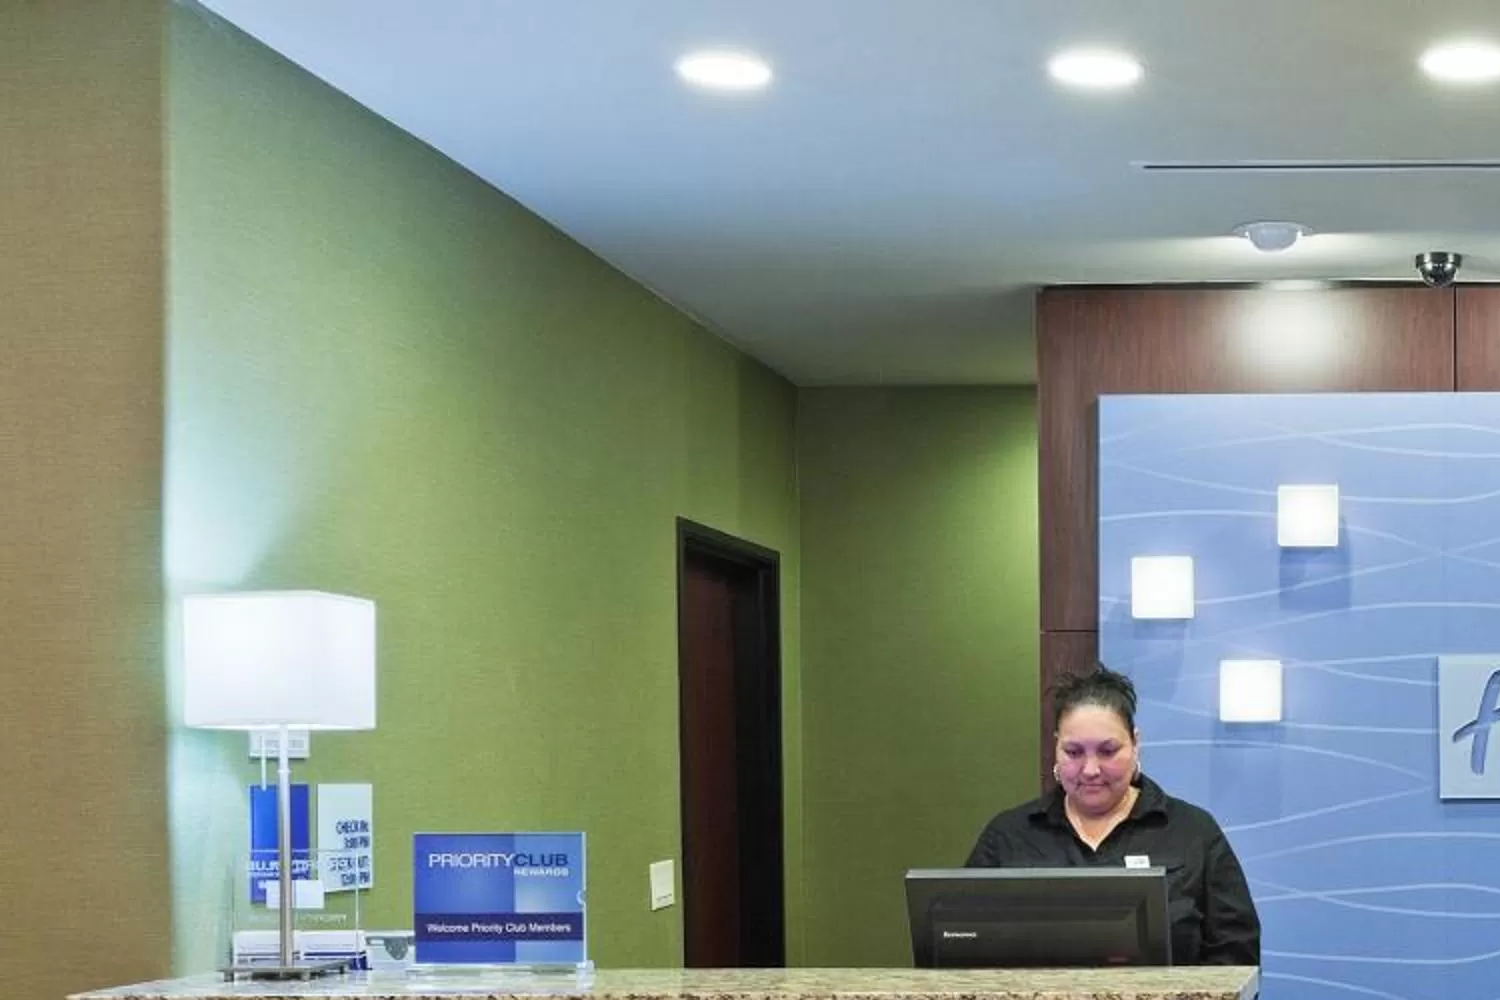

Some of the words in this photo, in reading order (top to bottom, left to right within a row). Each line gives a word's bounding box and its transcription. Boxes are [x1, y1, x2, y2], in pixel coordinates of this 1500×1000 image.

[513, 867, 570, 877] REWARDS
[426, 923, 469, 933] Welcome
[471, 922, 504, 935] Priority
[505, 922, 527, 933] Club
[529, 922, 572, 933] Members
